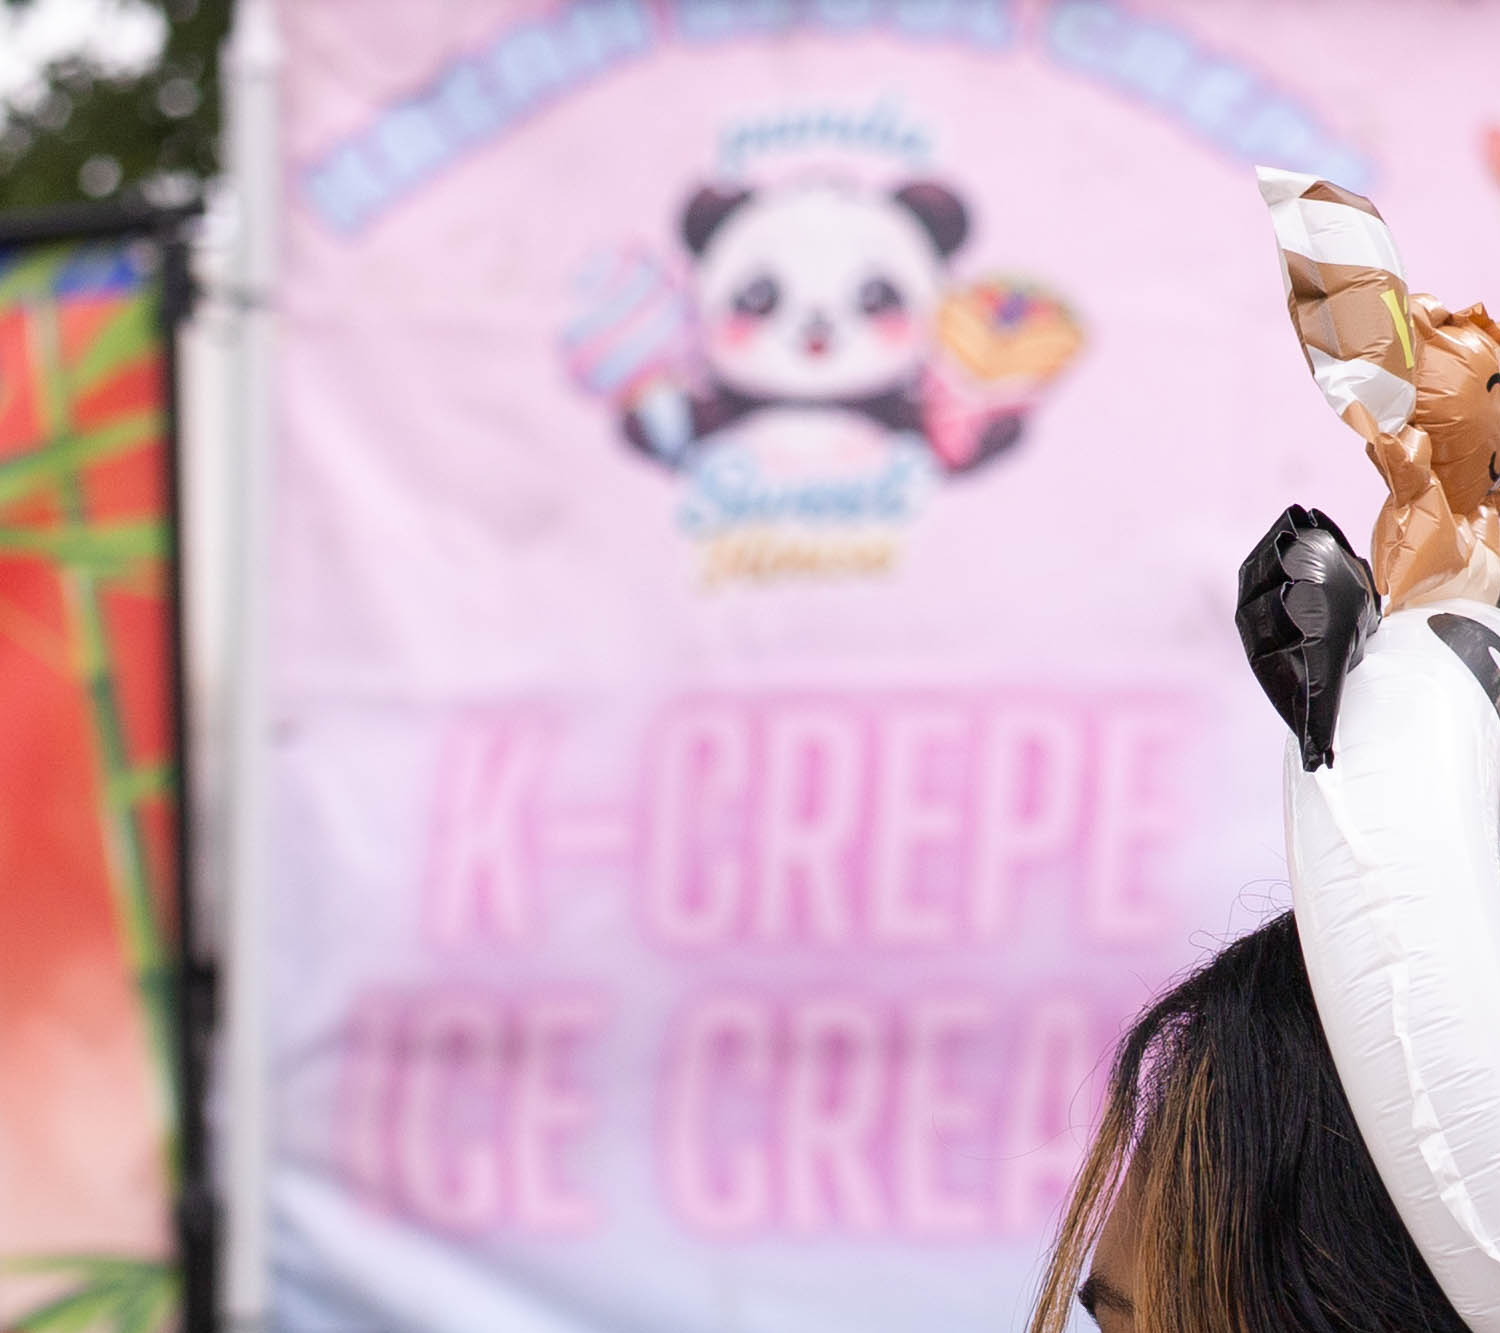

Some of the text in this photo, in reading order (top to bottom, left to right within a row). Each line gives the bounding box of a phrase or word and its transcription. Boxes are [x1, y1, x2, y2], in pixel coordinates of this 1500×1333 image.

[721, 93, 934, 172] panda
[680, 450, 922, 536] Sweet
[428, 696, 1188, 952] K-CREPE
[336, 990, 1110, 1244] ICE CREA
